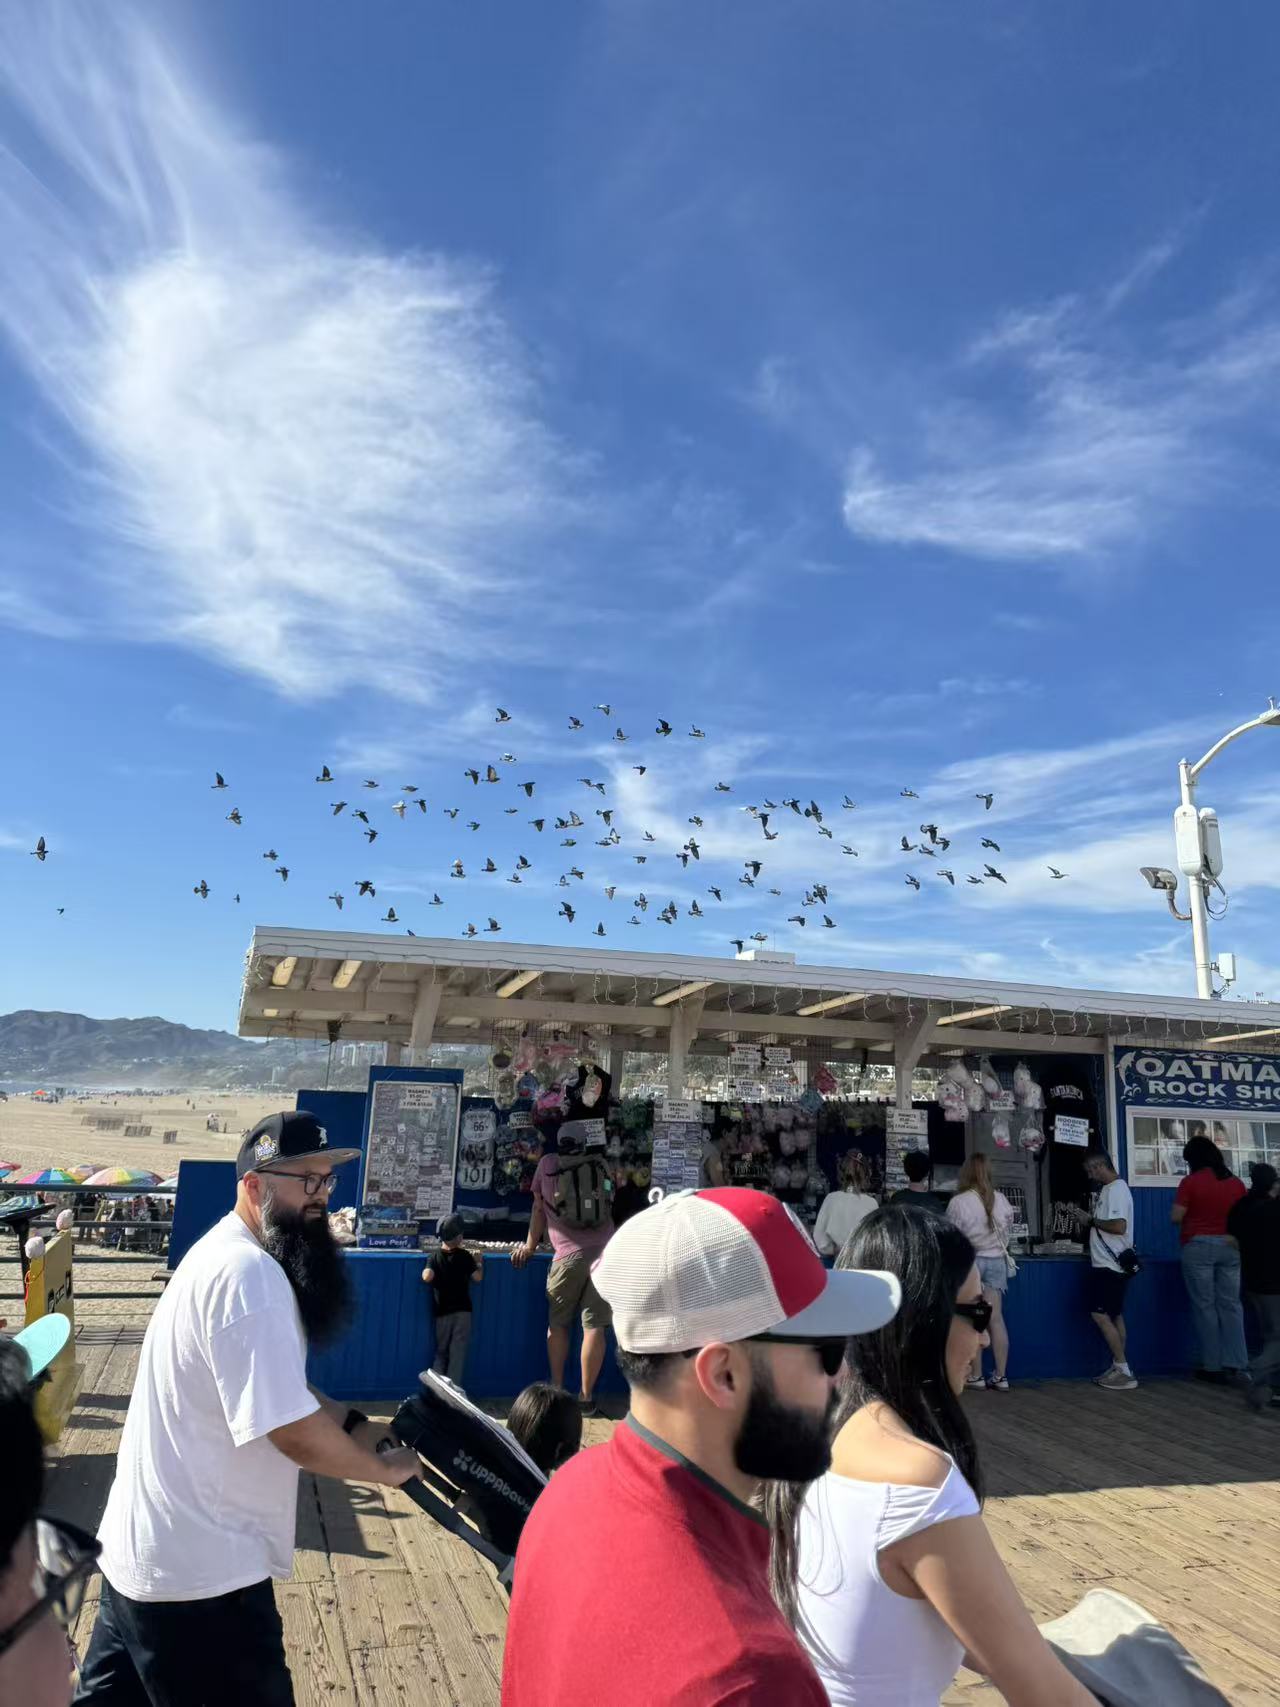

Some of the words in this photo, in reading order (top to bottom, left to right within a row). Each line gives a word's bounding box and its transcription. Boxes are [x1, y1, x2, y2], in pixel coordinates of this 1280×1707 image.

[1135, 1057, 1280, 1083] OATMA
[1147, 1080, 1227, 1098] ROCK
[473, 1122, 484, 1132] 66
[464, 1167, 486, 1183] 101
[368, 1238, 386, 1246] Love
